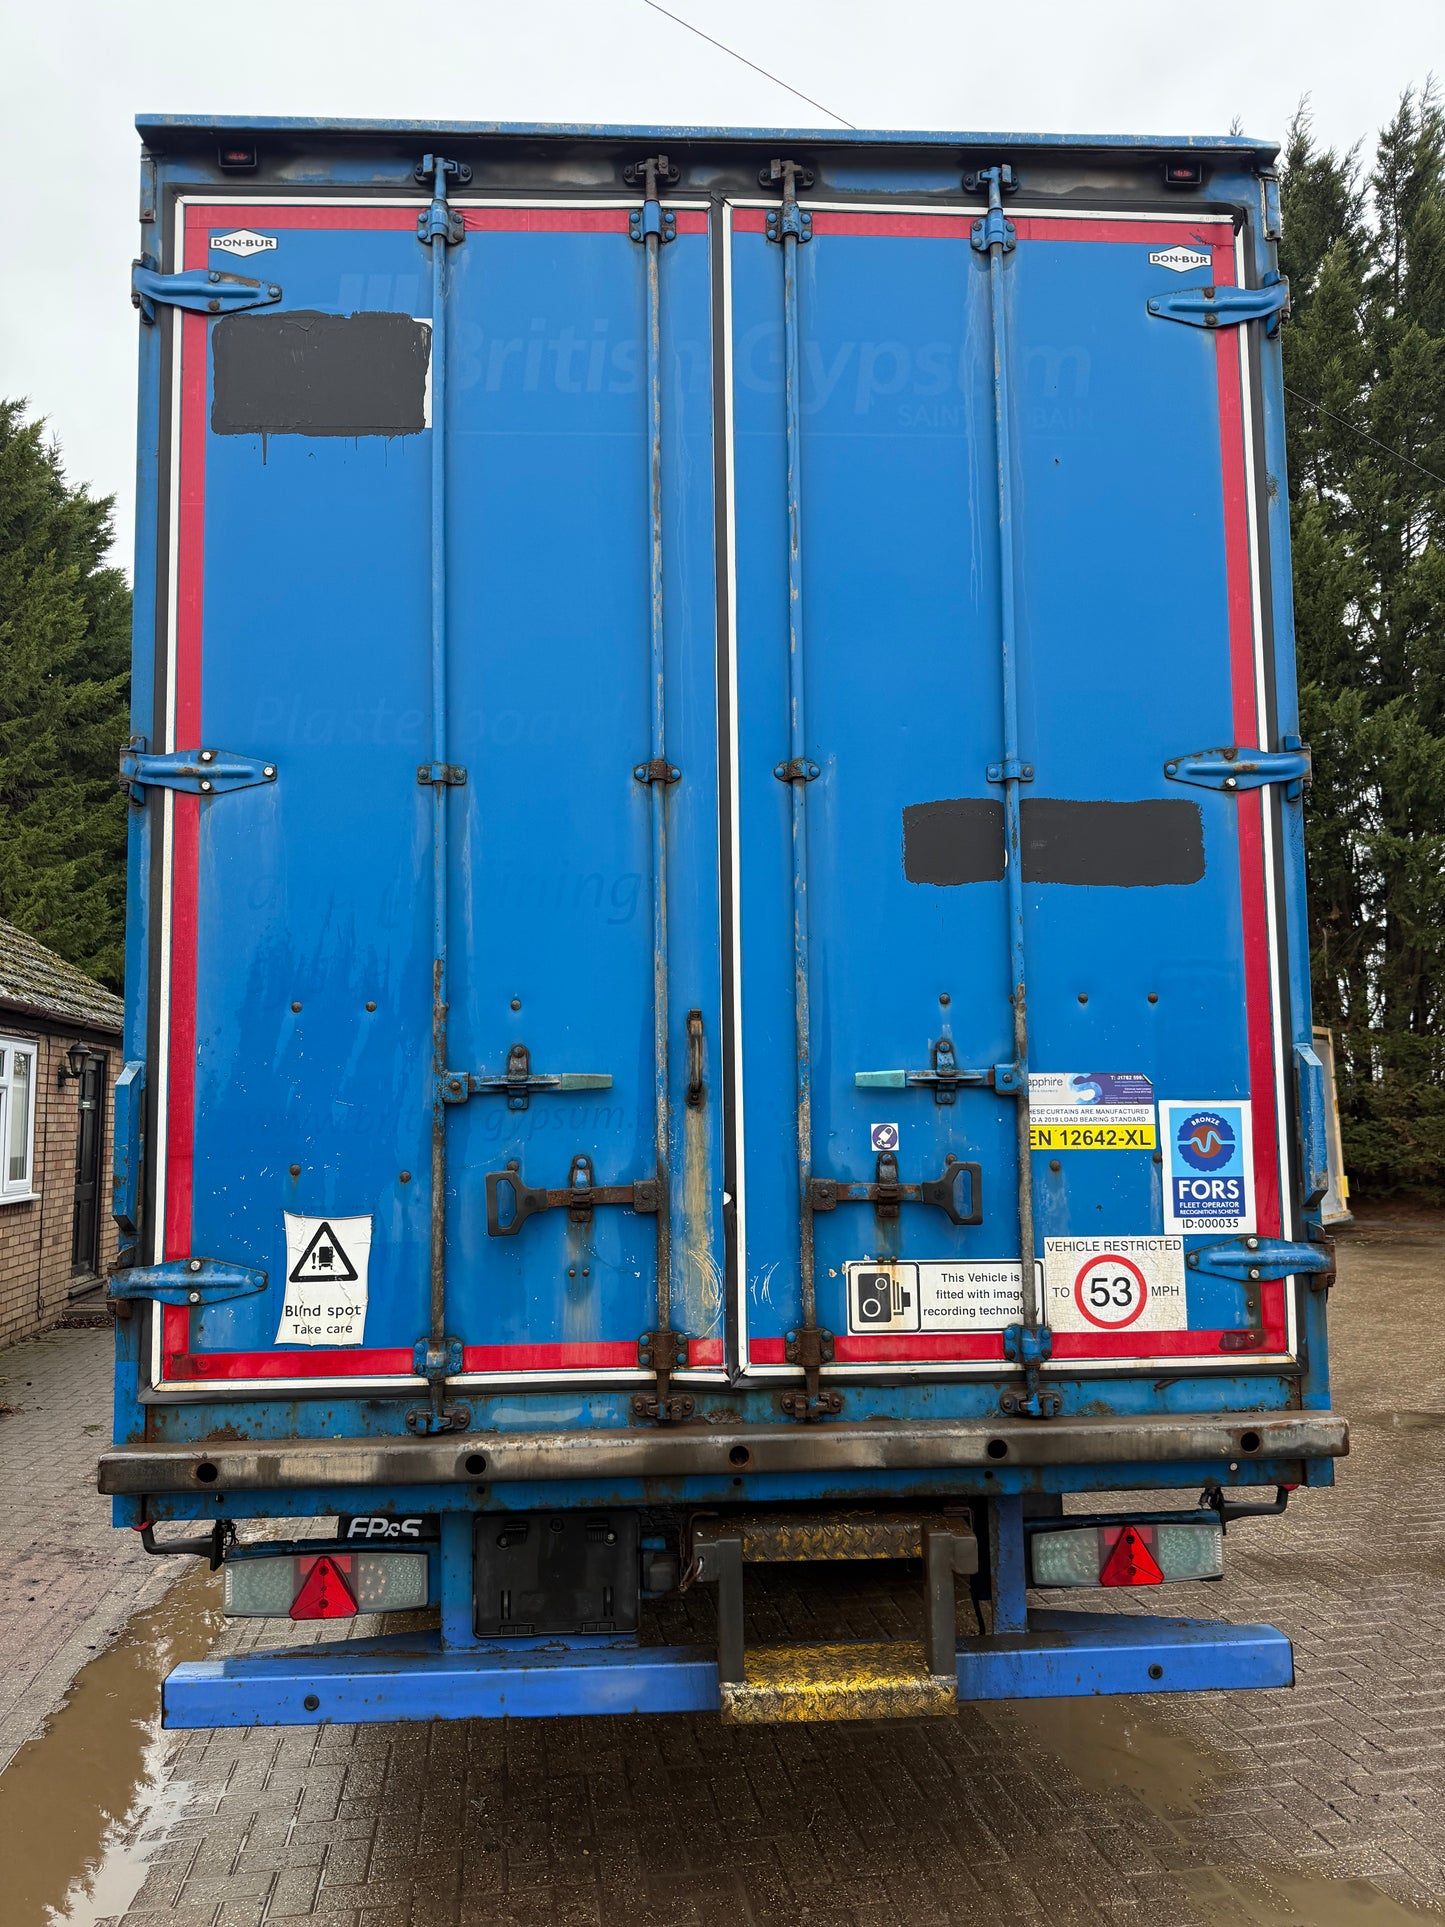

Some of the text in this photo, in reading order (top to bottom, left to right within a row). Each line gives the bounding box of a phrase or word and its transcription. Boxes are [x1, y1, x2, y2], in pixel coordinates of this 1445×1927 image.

[213, 239, 273, 247] DON-BUR
[1152, 255, 1208, 263] DON-BUR
[1028, 1076, 1063, 1088] apphire
[1192, 1116, 1220, 1126] BRONZE
[1060, 1130, 1151, 1146] 12642-XL
[1178, 1179, 1239, 1200] FORS
[1182, 1219, 1239, 1228] ID:000035
[1047, 1240, 1182, 1251] VEHICLE RESTRICTED
[941, 1272, 1020, 1283] This Vehicle is
[936, 1290, 964, 1299] fitted
[967, 1289, 990, 1299] with
[1052, 1276, 1179, 1307] TO 53 MPH
[285, 1305, 361, 1318] Blind spot
[923, 1306, 976, 1317] recording
[293, 1324, 353, 1334] Take care
